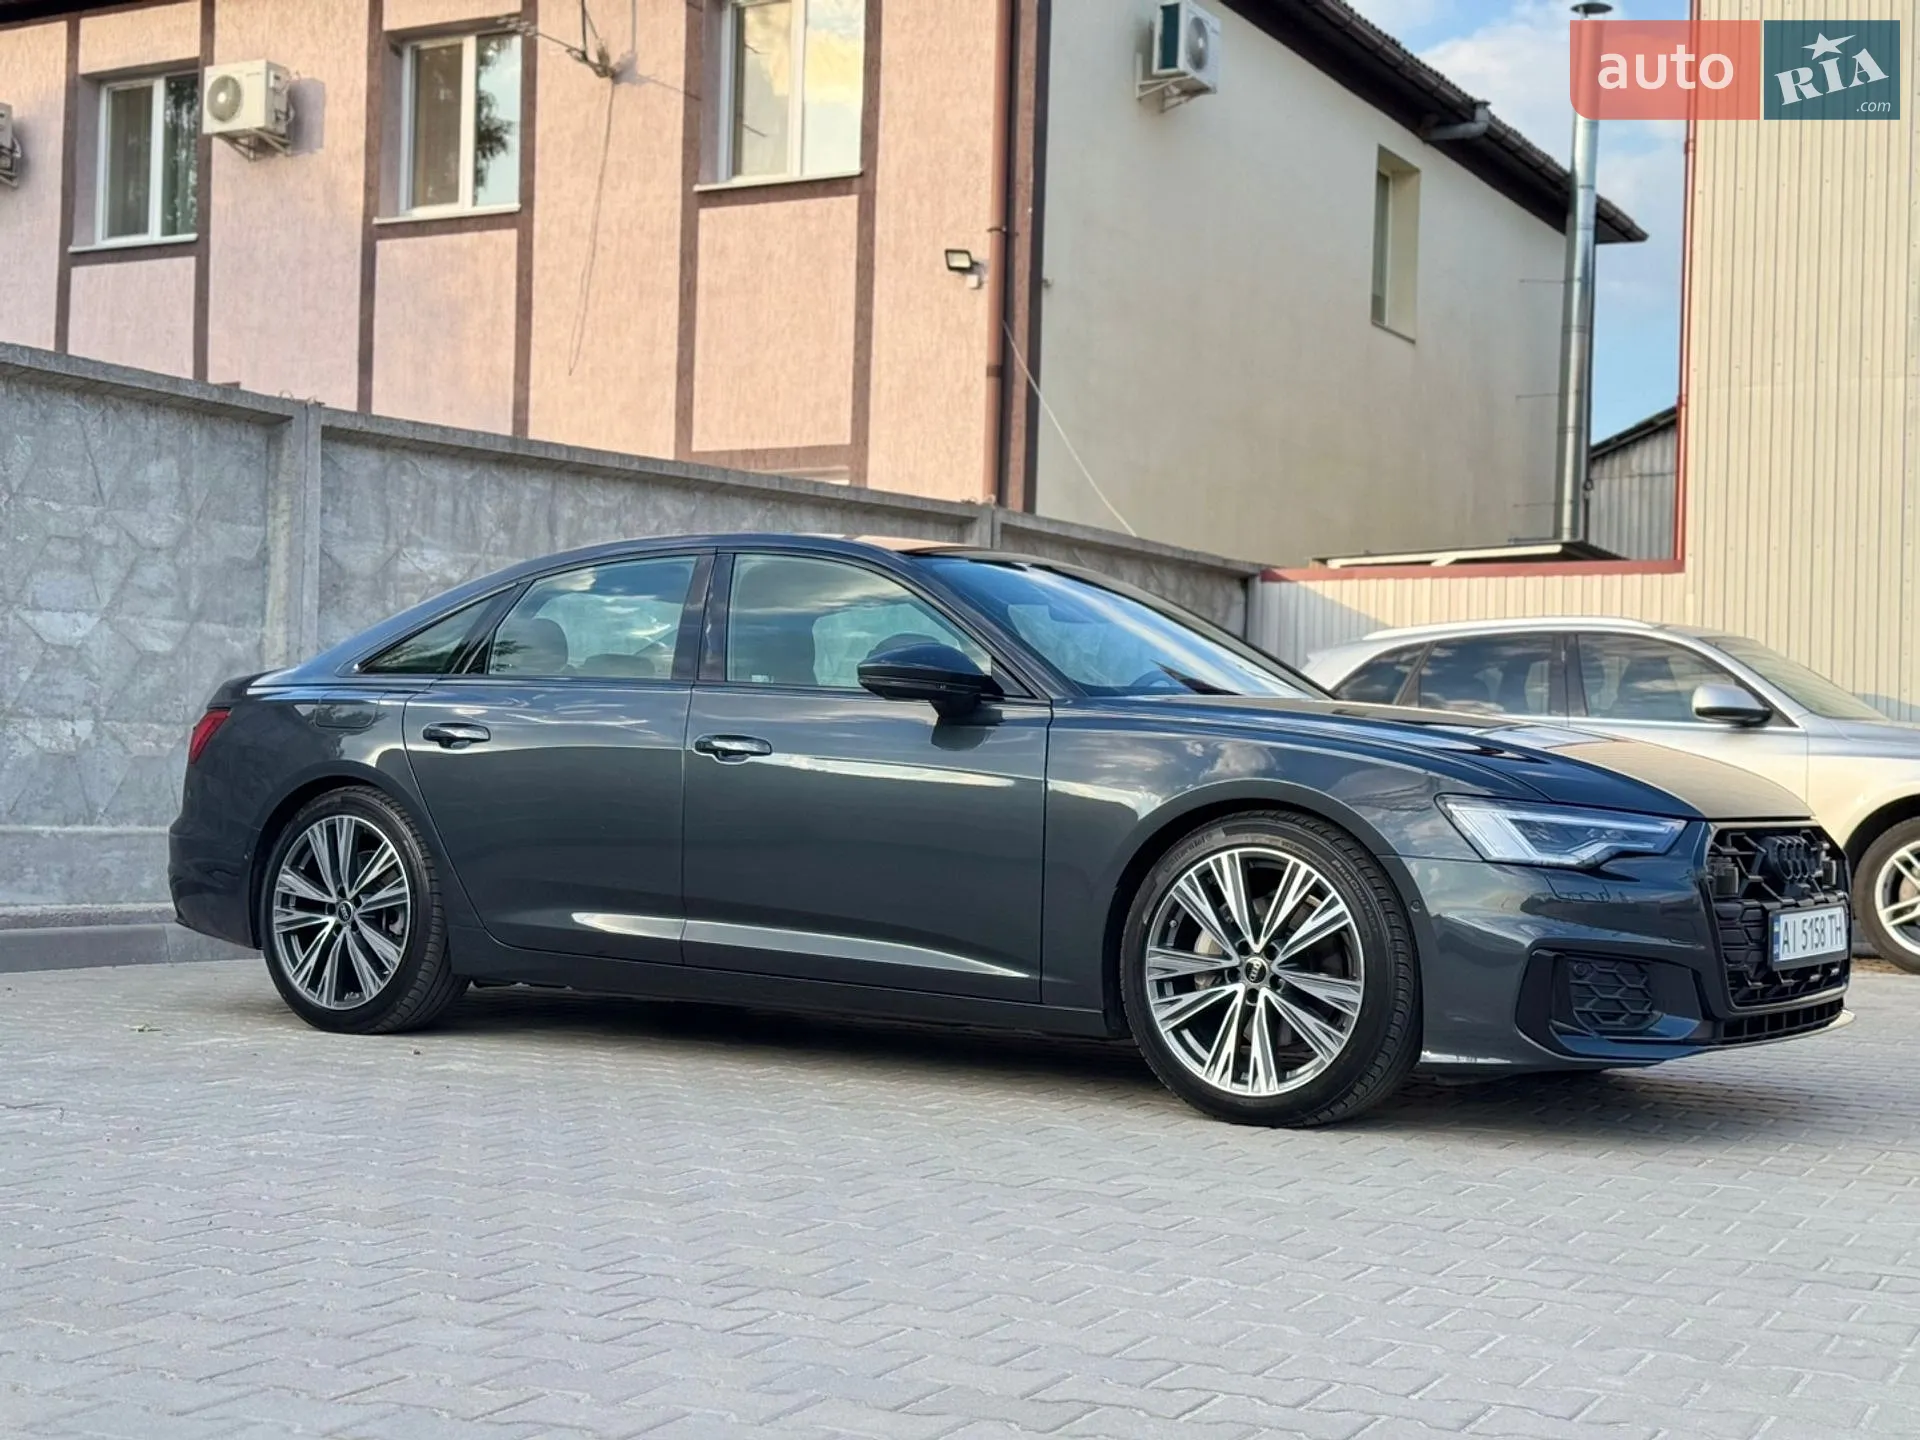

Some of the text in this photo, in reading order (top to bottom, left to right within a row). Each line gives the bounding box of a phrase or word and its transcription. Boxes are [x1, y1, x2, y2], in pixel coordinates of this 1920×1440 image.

[1781, 913, 1844, 954] AI 5158 TH
